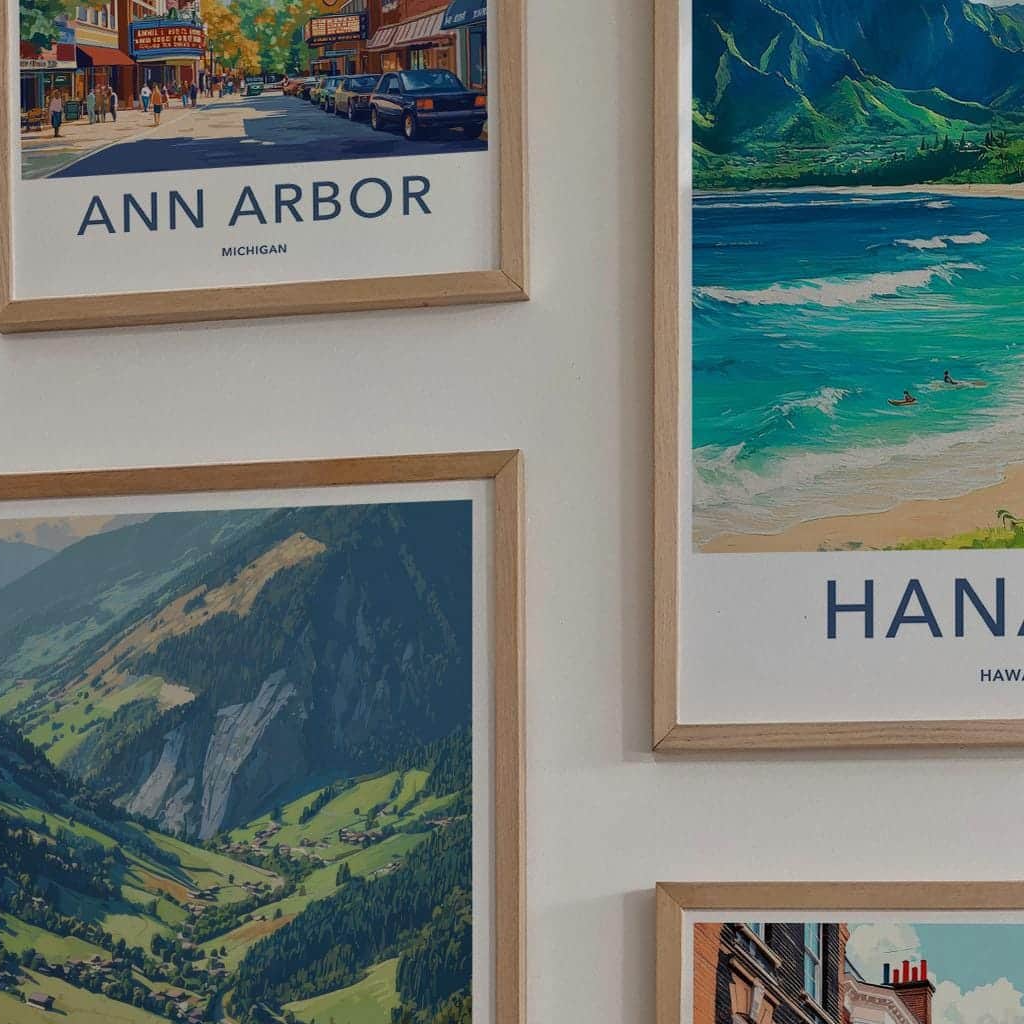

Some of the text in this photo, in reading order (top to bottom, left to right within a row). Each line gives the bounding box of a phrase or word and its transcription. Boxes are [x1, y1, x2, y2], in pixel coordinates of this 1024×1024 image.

[77, 175, 432, 236] ANN ARBOR
[221, 243, 288, 257] MICHIGAN
[826, 577, 1024, 640] HAN
[980, 669, 1024, 682] HAW
